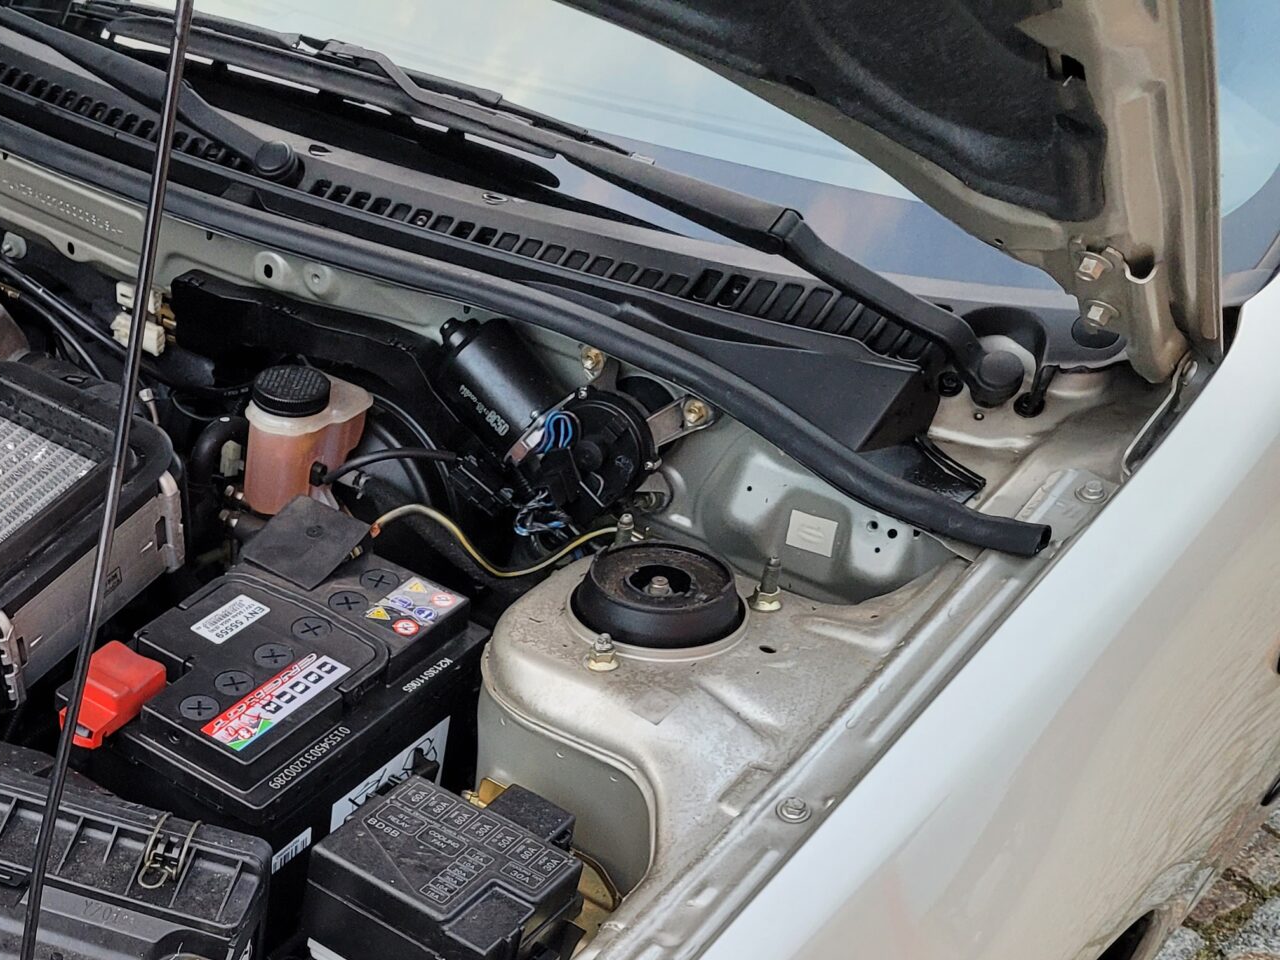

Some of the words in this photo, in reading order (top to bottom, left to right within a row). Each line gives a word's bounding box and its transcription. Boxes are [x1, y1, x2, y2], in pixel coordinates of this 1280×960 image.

[243, 606, 265, 621] ENY
[215, 620, 244, 639] 55559
[367, 817, 400, 838] BD6B
[387, 815, 411, 828] RELAY
[475, 823, 493, 837] 30A
[428, 830, 460, 849] COOLING
[431, 838, 447, 849] FAN
[498, 834, 515, 848] 50A
[520, 846, 538, 860] 60A
[543, 858, 560, 872] 30A
[509, 870, 530, 884] 30A
